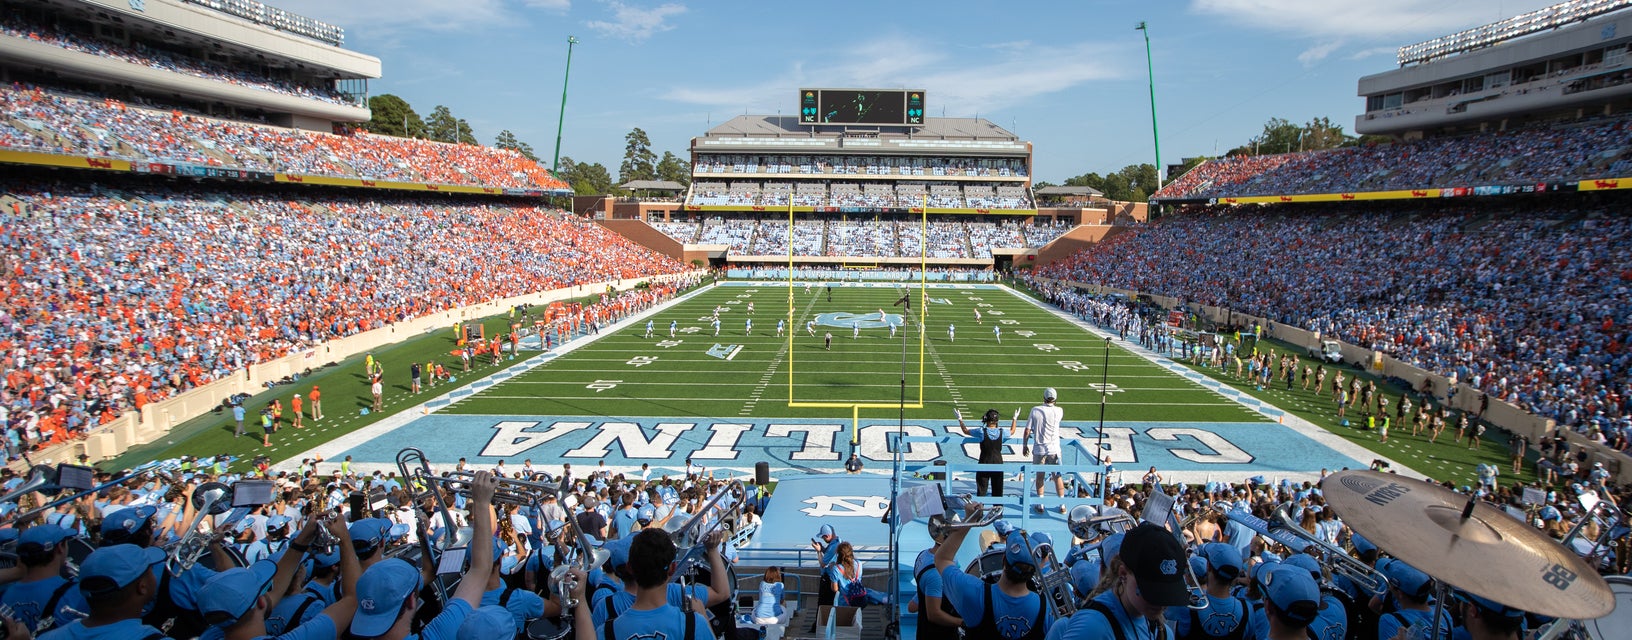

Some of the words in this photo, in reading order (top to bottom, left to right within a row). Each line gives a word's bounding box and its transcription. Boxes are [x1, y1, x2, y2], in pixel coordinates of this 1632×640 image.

[1365, 482, 1411, 506] SABIAN
[1244, 514, 1297, 543] CARINA
[1542, 563, 1578, 590] B8
